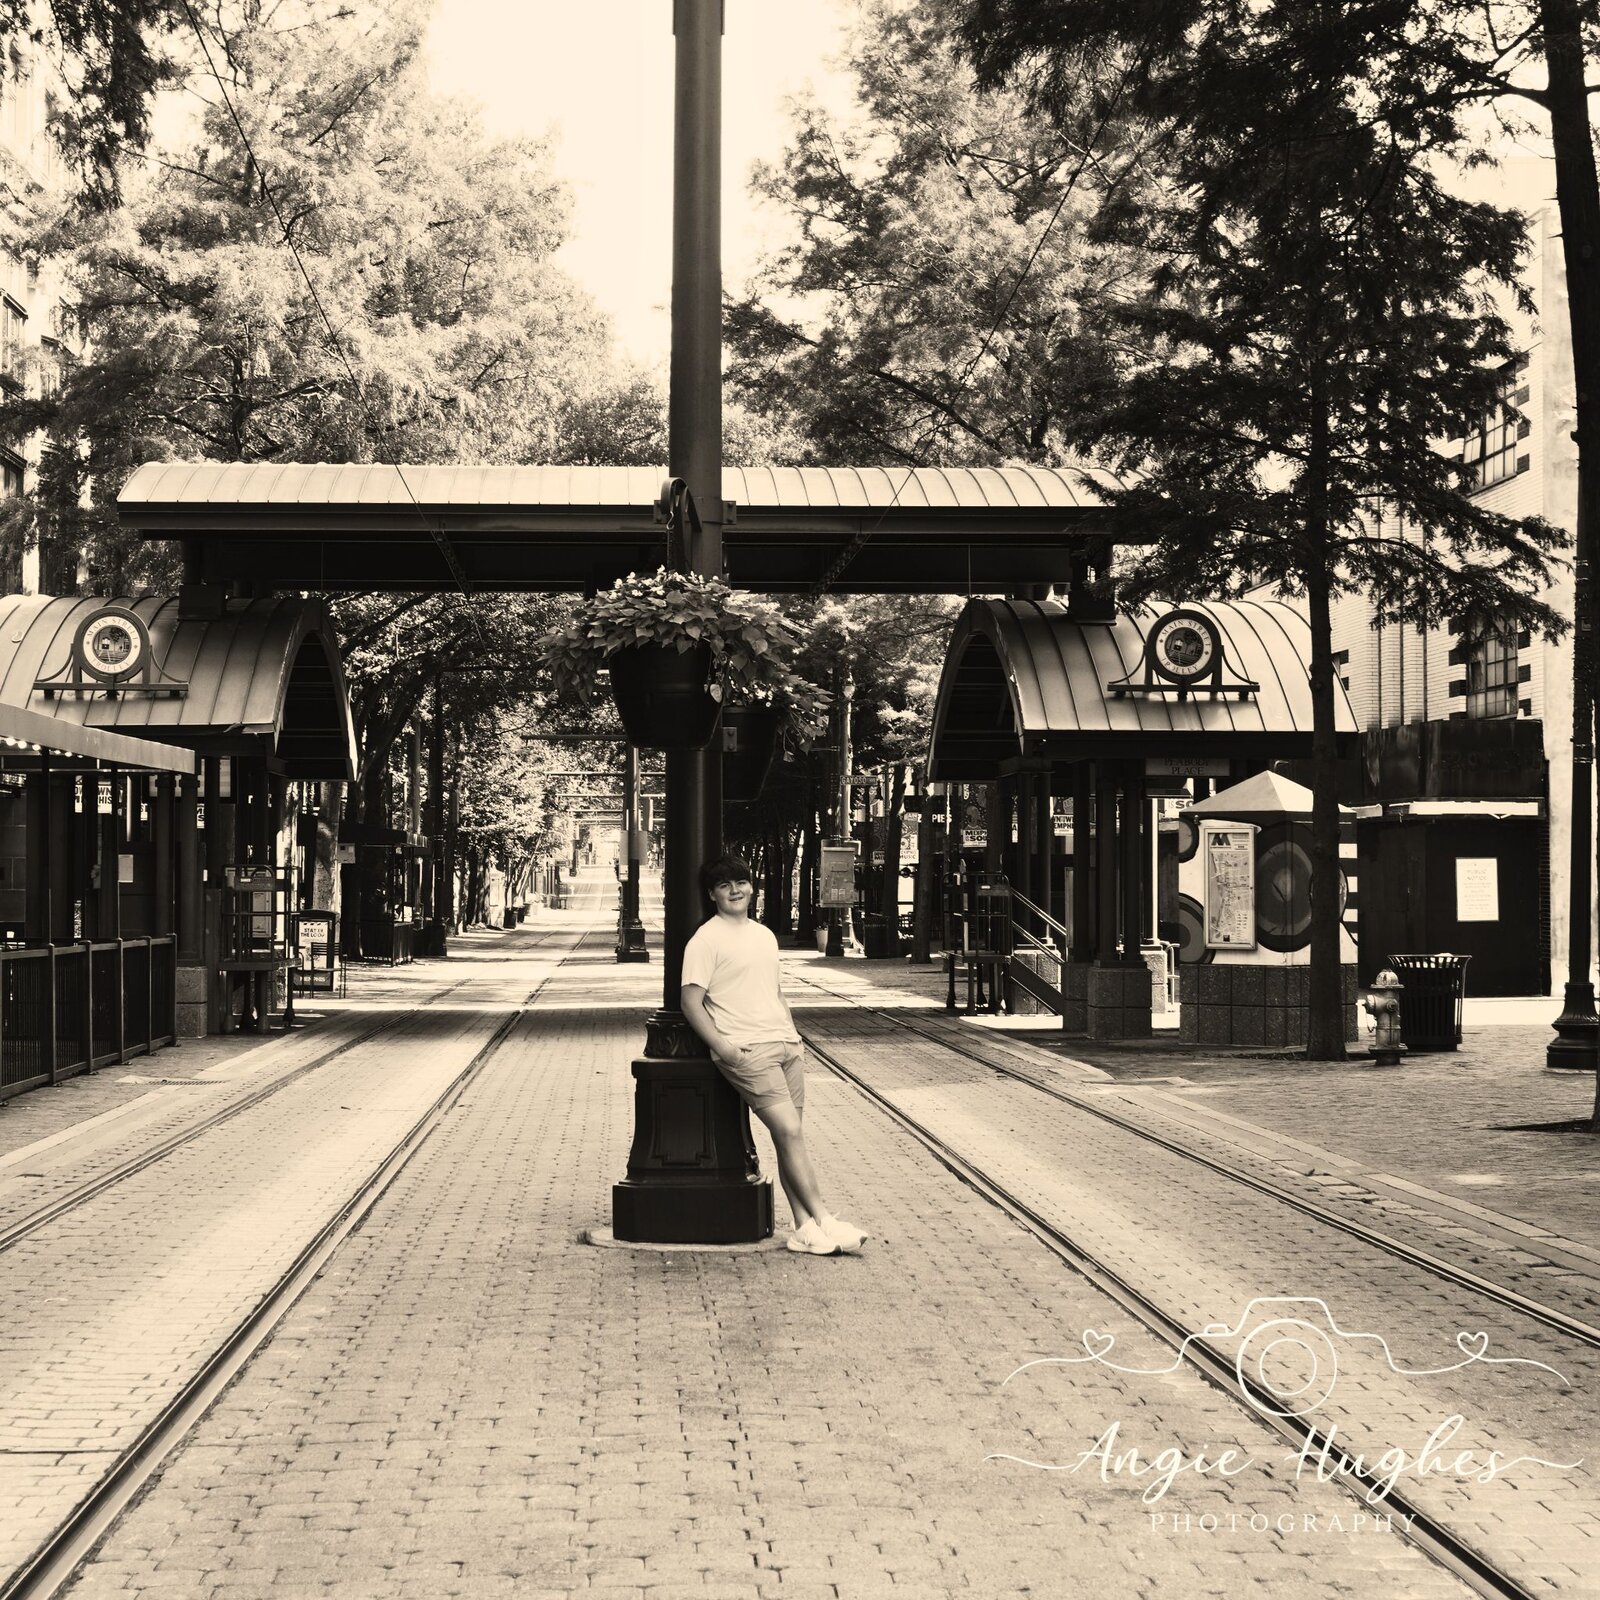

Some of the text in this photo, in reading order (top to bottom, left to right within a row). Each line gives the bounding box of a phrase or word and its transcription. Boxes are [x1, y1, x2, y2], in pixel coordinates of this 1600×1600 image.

[86, 618, 138, 640] MAIN STREET
[1161, 620, 1212, 647] MAIN STREET
[92, 657, 130, 672] TROLLEY
[1171, 766, 1204, 775] PLACE
[841, 776, 866, 784] GAYOSO
